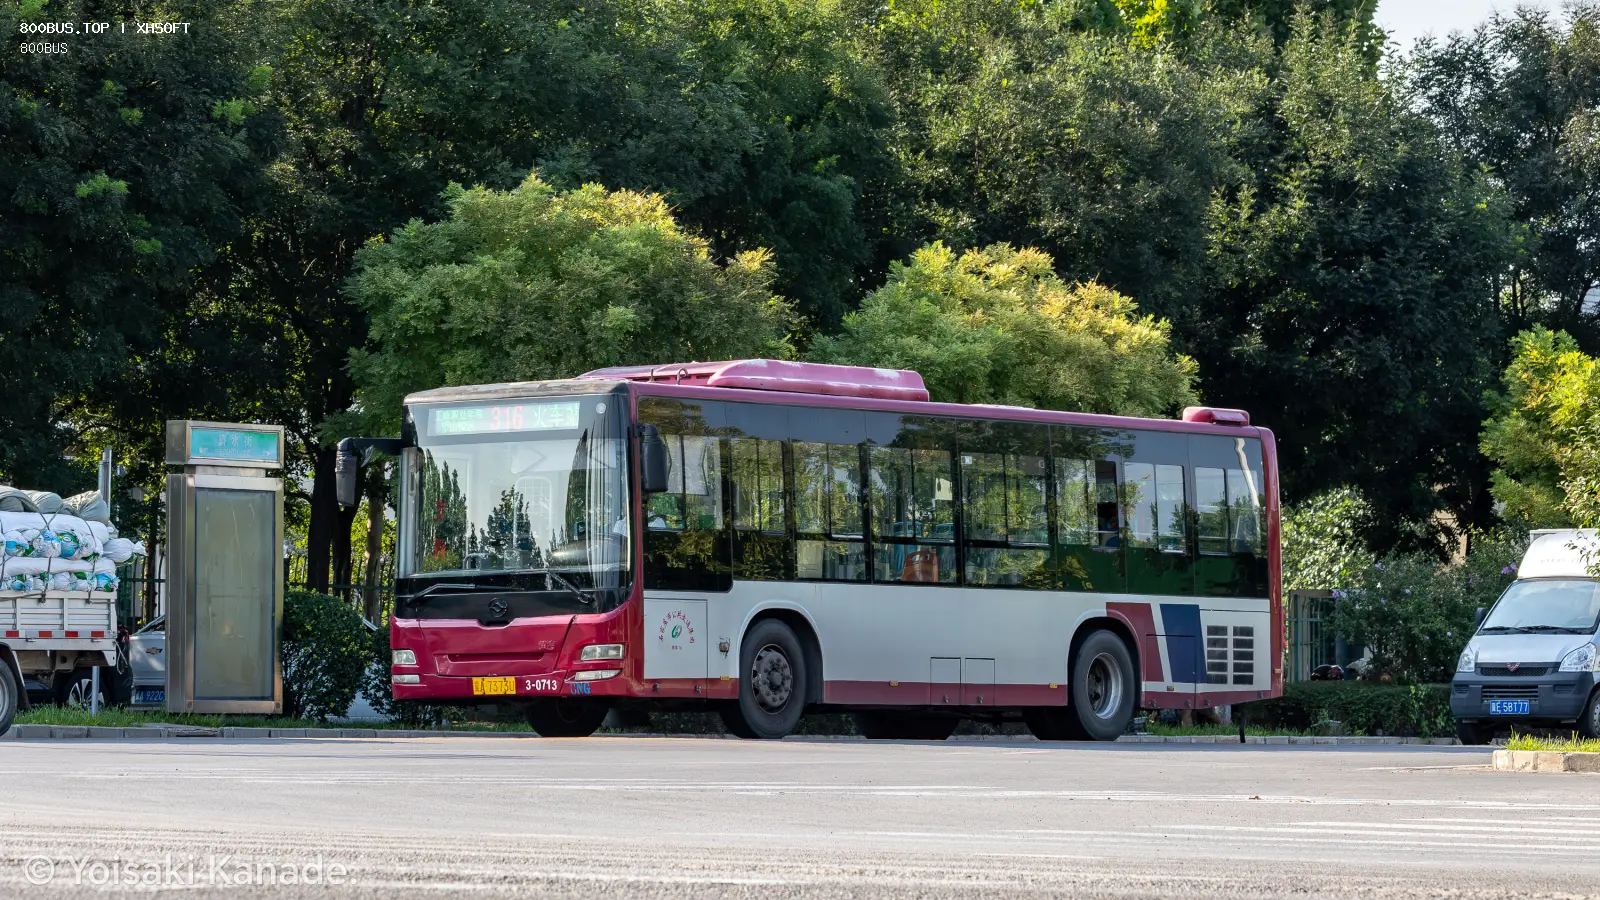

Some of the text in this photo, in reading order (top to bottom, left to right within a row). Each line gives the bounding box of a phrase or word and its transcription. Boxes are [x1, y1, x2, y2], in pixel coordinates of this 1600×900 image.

[490, 405, 524, 431] 316
[532, 402, 580, 429] 火车站
[525, 679, 558, 691] 3-0713
[569, 682, 591, 695] CNG
